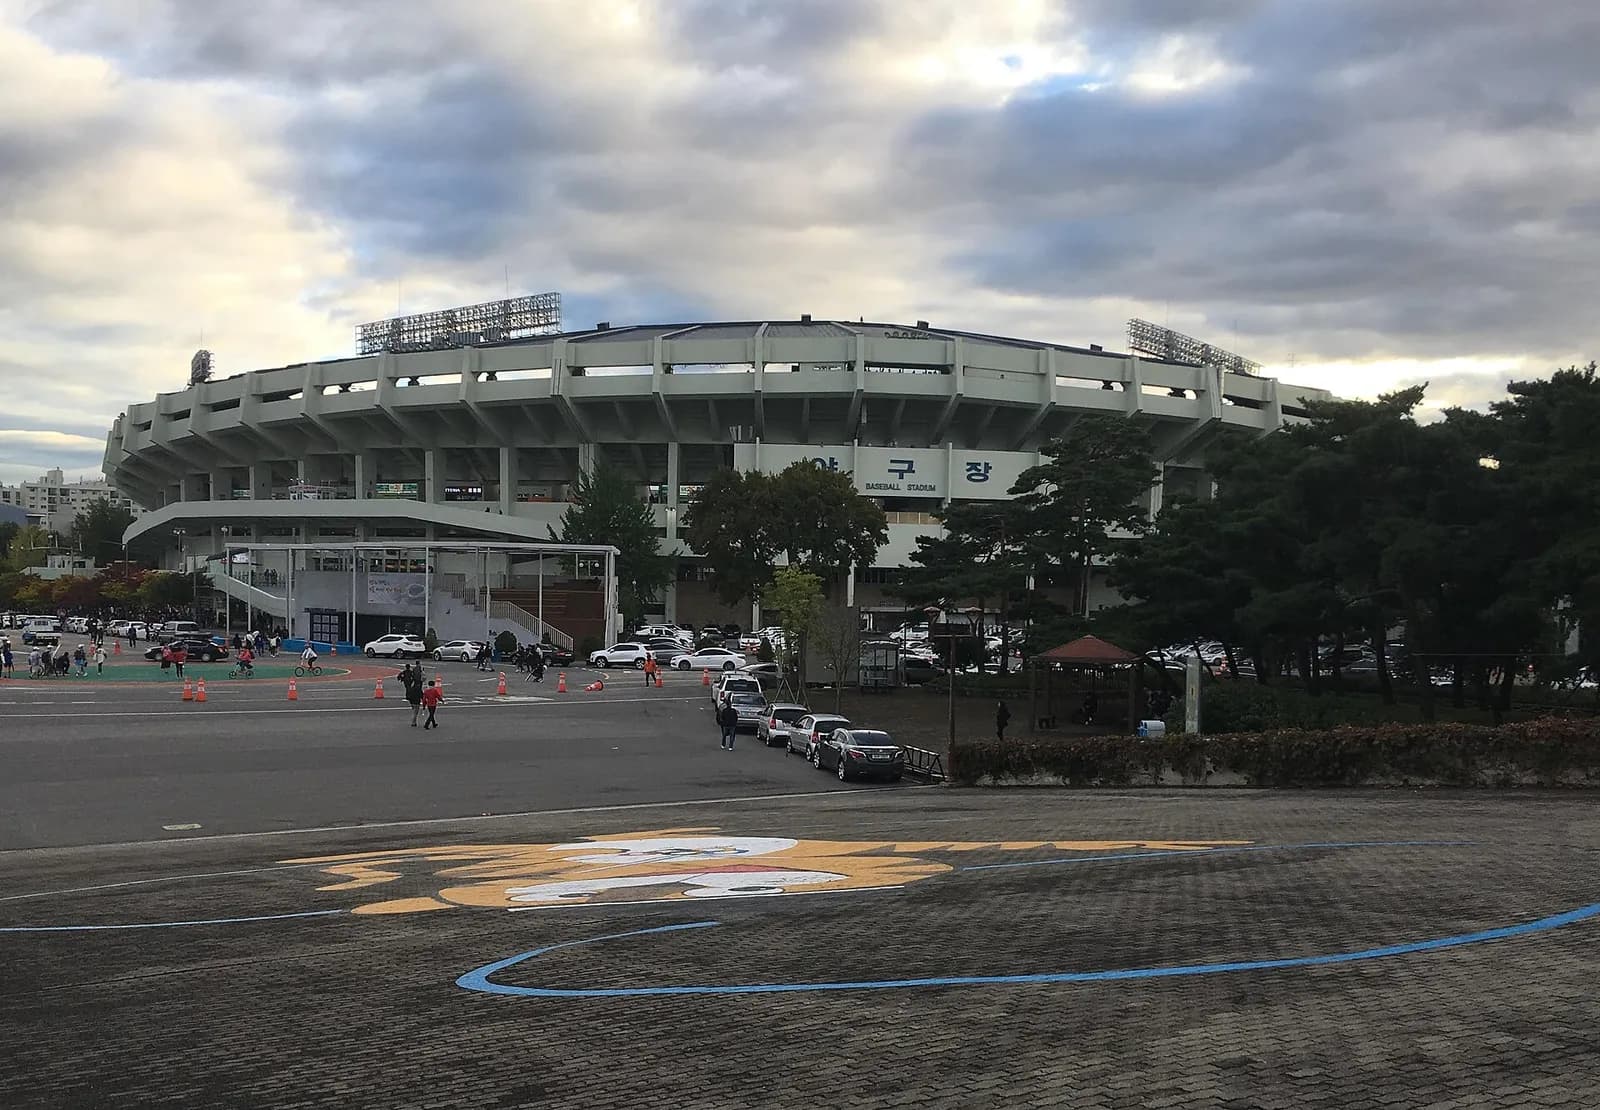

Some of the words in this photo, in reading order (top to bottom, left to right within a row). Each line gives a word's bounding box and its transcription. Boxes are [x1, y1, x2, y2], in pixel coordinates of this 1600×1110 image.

[887, 459, 915, 480] 구
[965, 461, 993, 483] 장
[865, 482, 902, 491] BASEBALL
[906, 483, 936, 492] STADIUM
